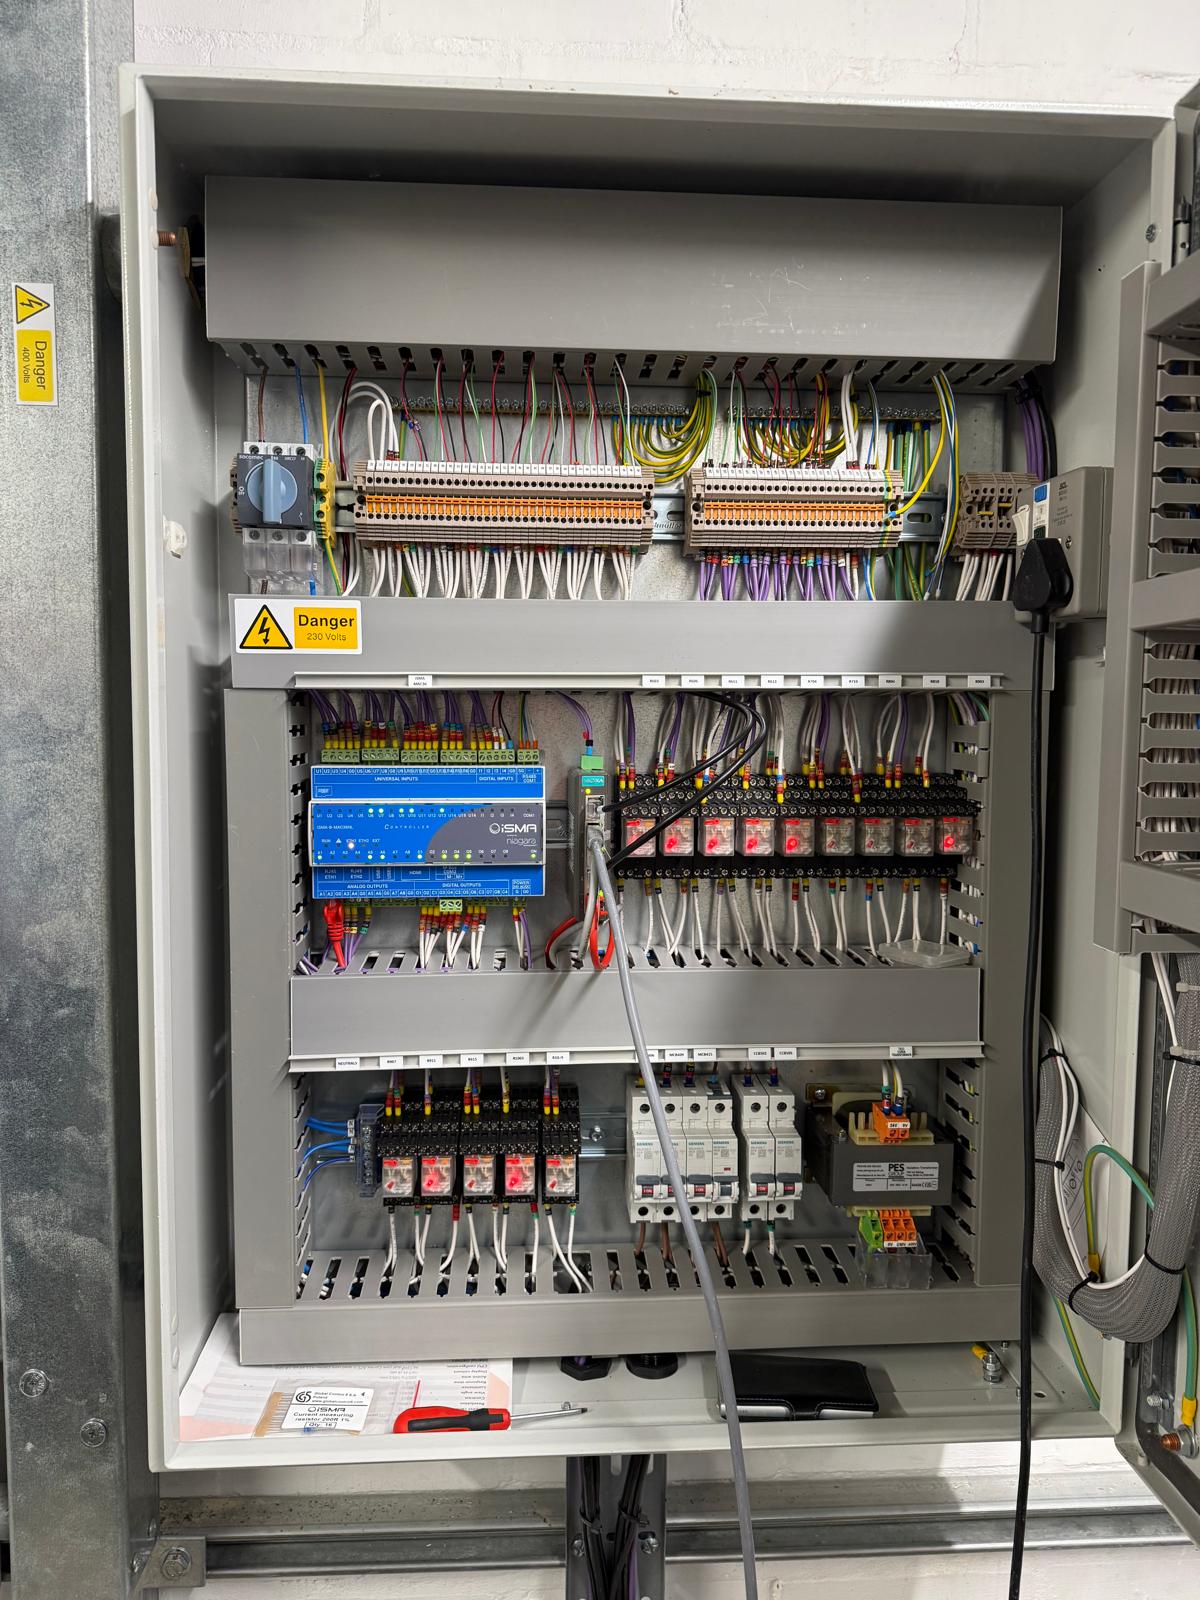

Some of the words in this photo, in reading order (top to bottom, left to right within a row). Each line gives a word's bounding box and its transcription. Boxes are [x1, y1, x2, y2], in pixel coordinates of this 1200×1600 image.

[22, 347, 30, 362] 400
[33, 340, 47, 390] Danger
[23, 363, 31, 384] Volts
[298, 614, 355, 627] Danger
[306, 632, 323, 641] 230
[325, 632, 347, 642] Volts
[501, 823, 537, 833] iSMA
[888, 1163, 905, 1172] PES
